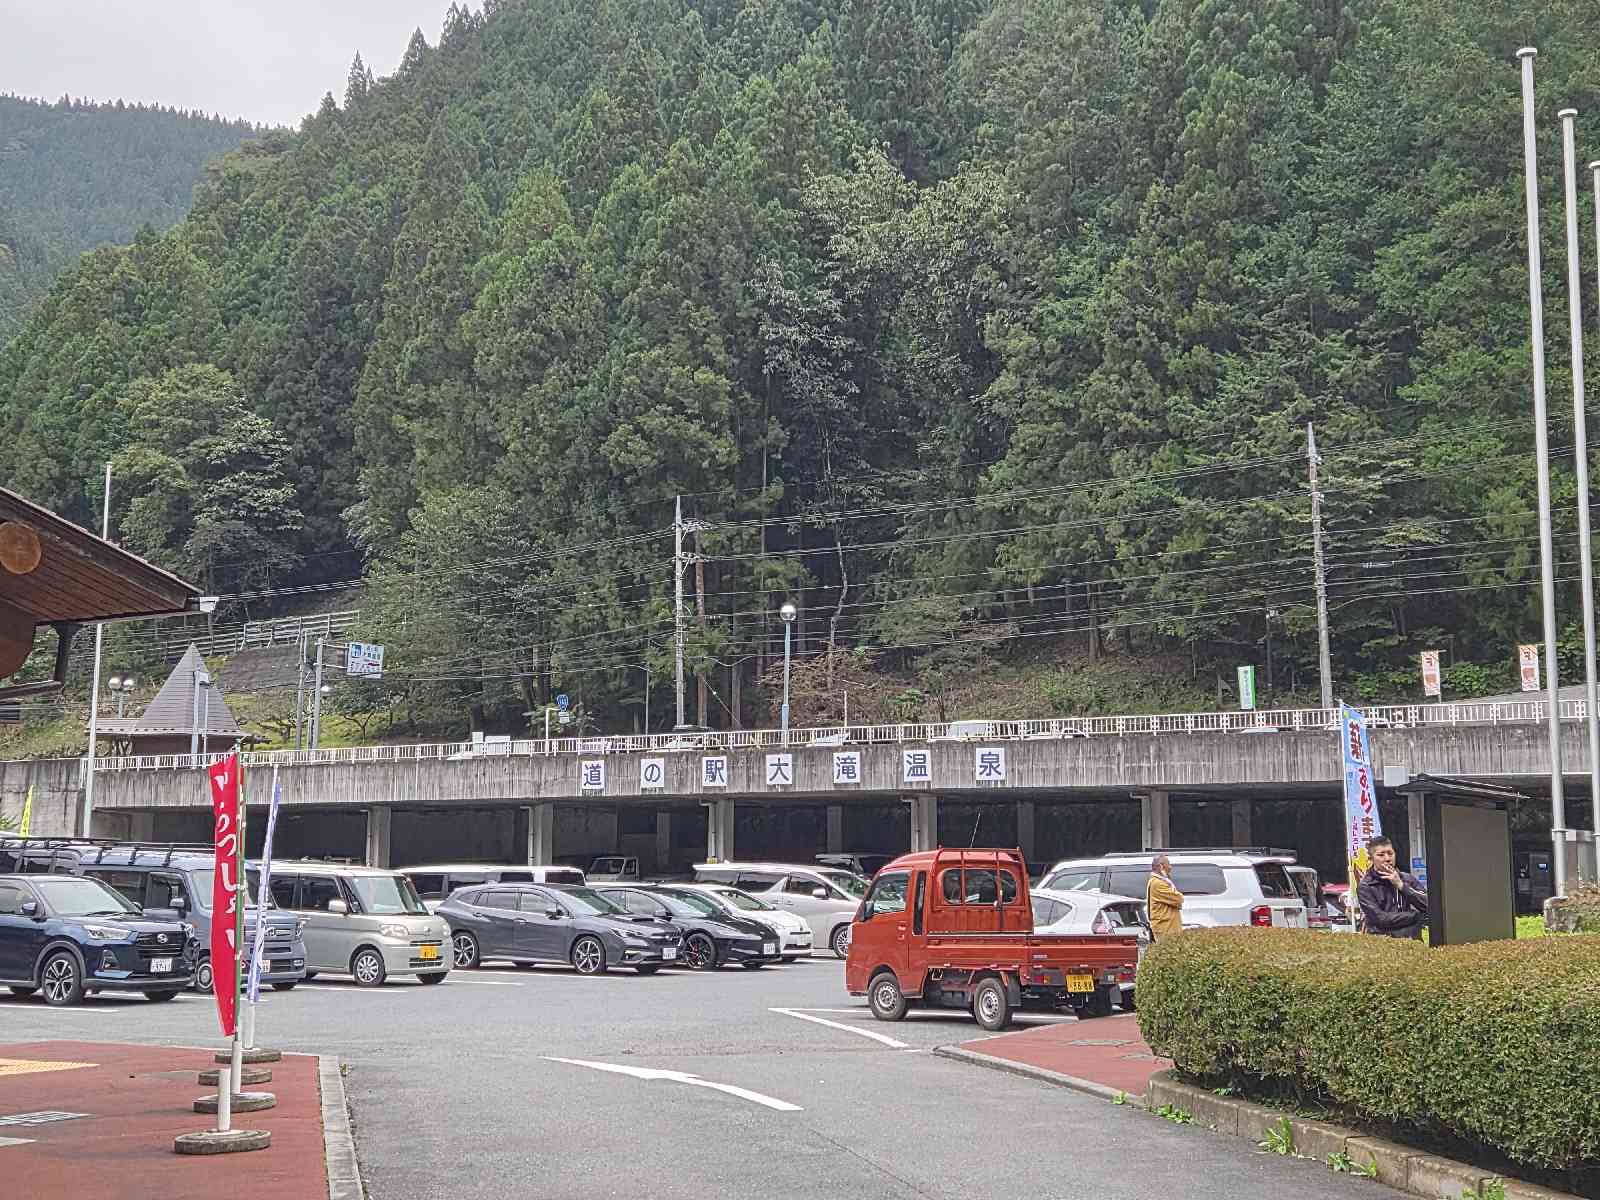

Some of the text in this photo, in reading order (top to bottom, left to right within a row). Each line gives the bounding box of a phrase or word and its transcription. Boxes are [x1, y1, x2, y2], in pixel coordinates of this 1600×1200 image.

[583, 751, 1002, 786] 道の駅大滝温泉
